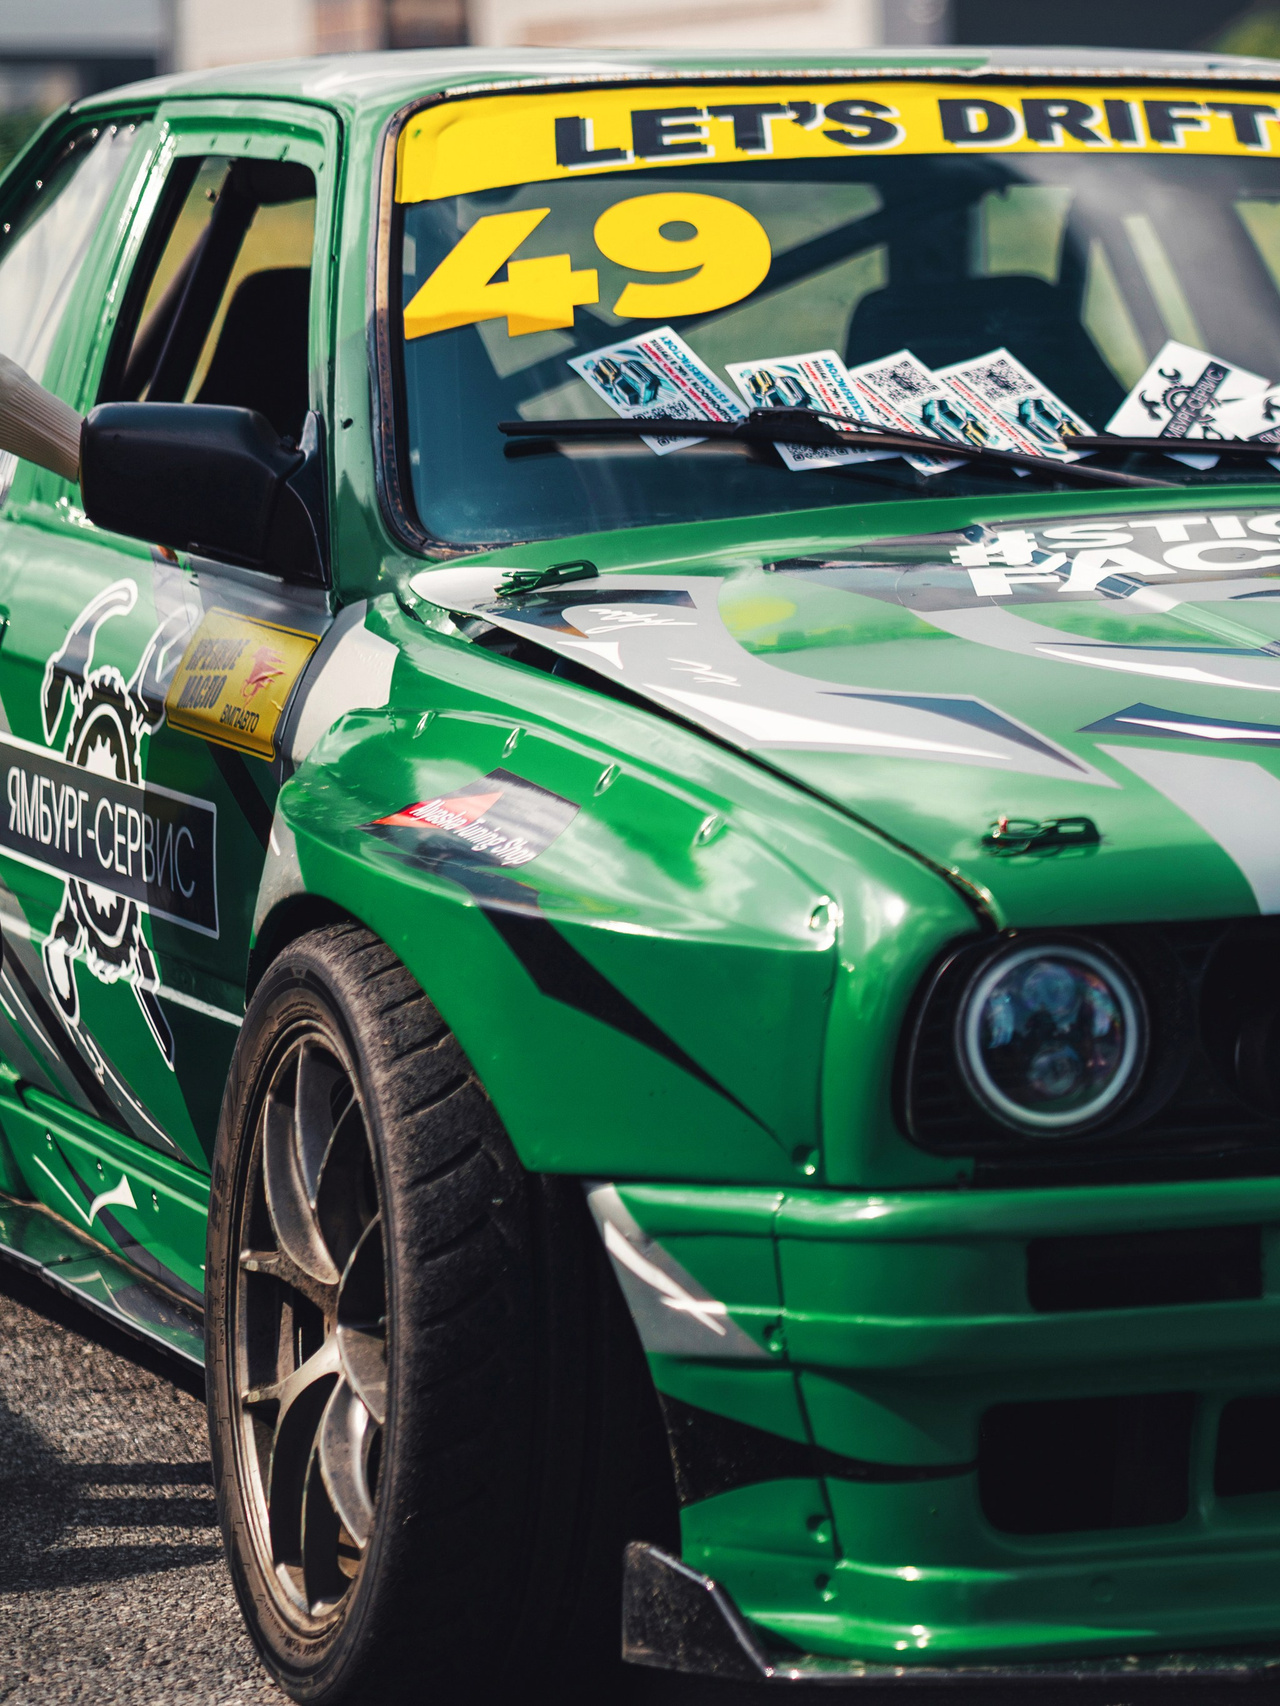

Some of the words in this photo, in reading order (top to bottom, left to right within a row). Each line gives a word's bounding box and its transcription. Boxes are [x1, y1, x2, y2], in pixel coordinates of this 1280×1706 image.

[554, 98, 905, 171] LET'S
[403, 192, 772, 340] 49
[691, 381, 735, 422] ОДРОБНОСТИ
[1163, 367, 1224, 439] МБУРГ-СЕРВИС
[177, 675, 227, 709] МАСЛО
[220, 703, 260, 734] ВМПАВТО
[7, 765, 196, 899] ЯМБУРГ-СЕРВИС
[453, 817, 506, 852] Tuning
[490, 836, 537, 866] Shop
